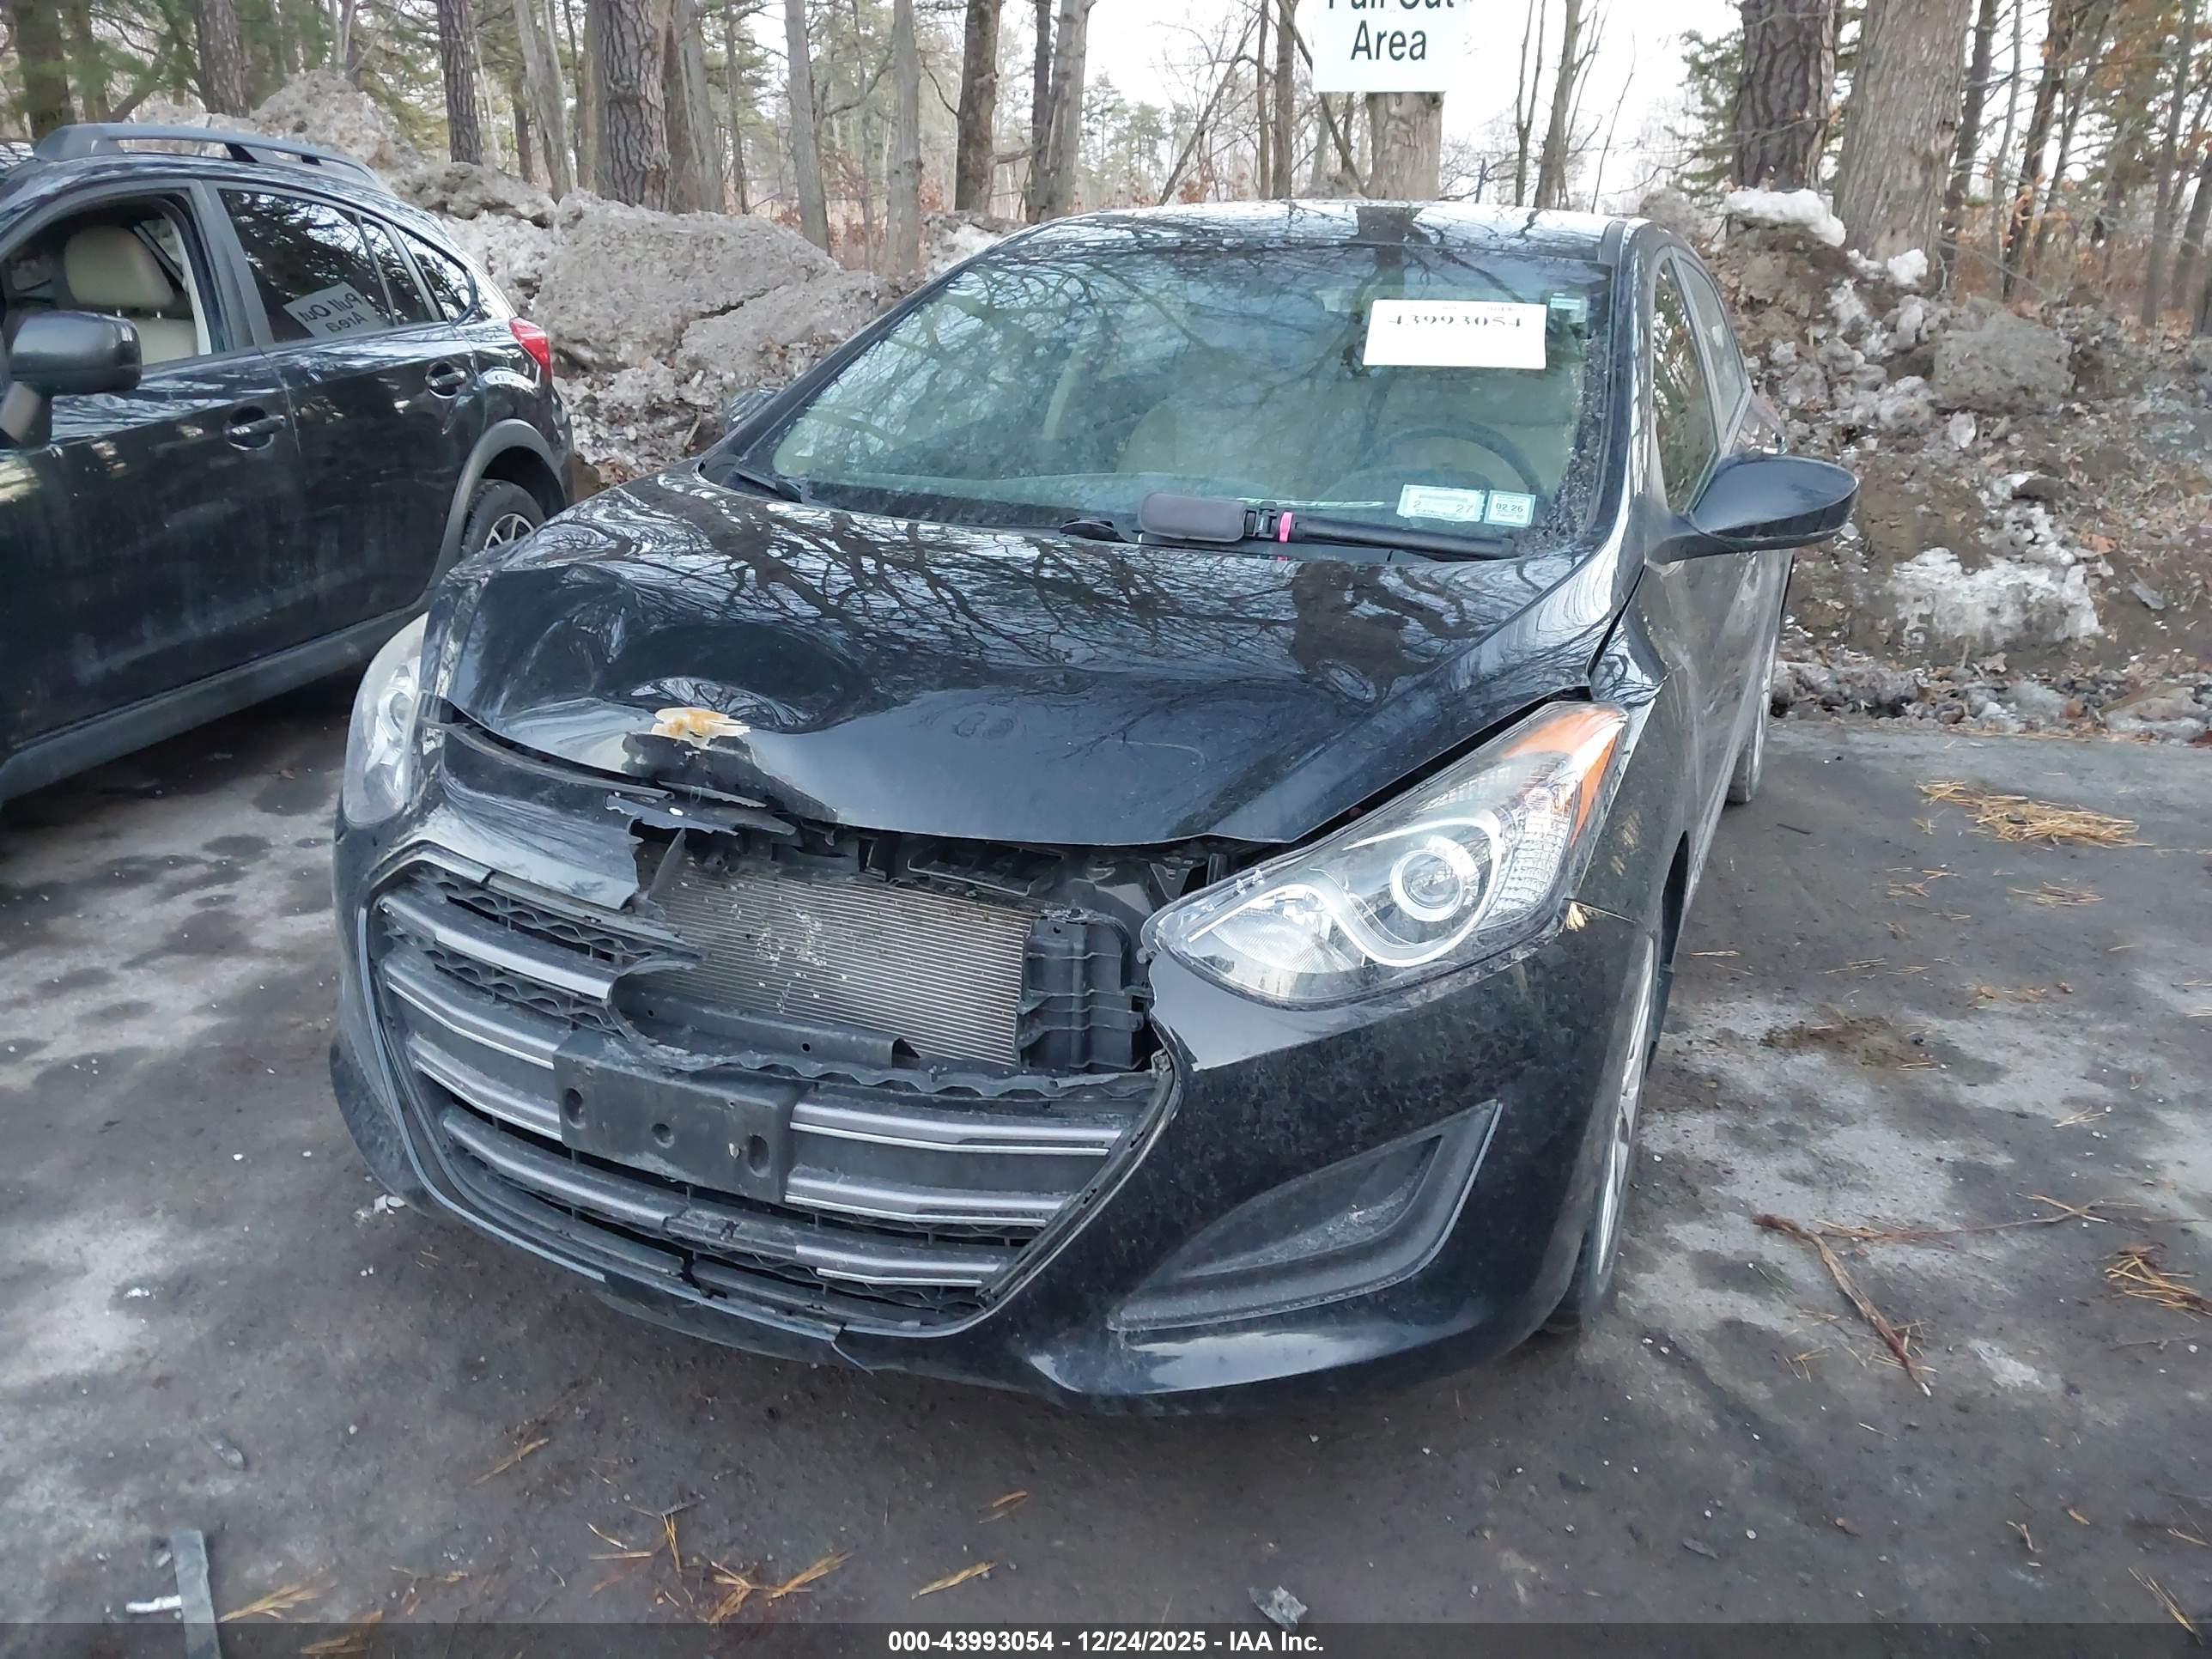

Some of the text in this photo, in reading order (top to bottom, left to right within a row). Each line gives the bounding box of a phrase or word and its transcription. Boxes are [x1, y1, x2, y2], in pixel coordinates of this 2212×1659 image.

[1350, 20, 1427, 61] Area
[1388, 314, 1522, 328] 43993054
[1455, 504, 1474, 514] 27
[1496, 502, 1508, 511] 02
